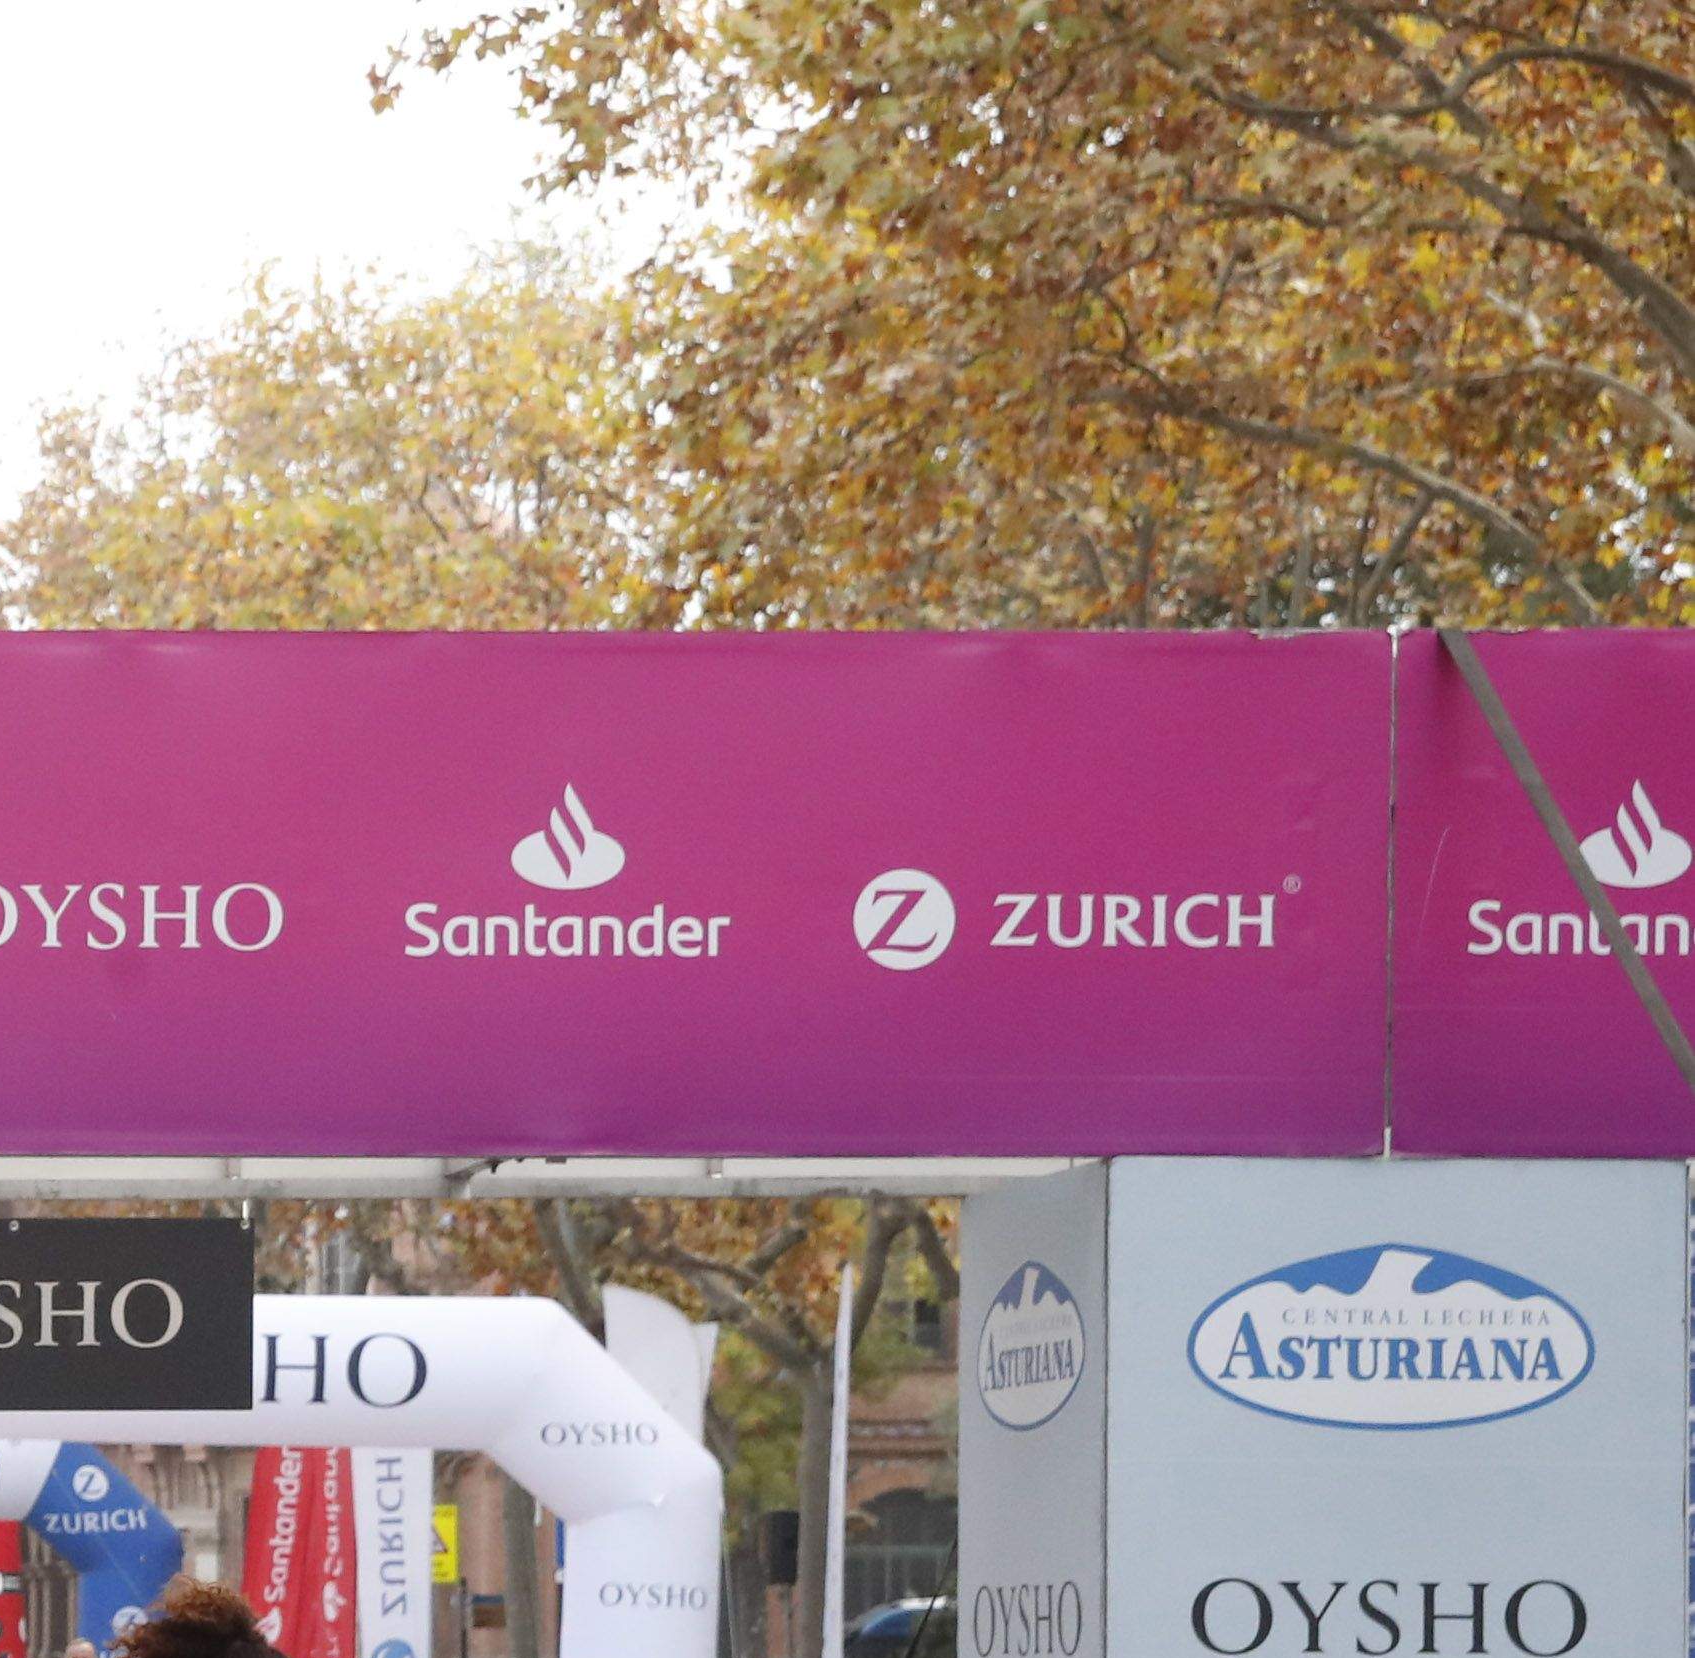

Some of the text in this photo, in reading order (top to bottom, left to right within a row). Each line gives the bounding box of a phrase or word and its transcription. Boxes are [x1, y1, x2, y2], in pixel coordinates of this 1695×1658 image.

[403, 901, 731, 960] Santander
[989, 892, 1277, 949] ZURICH
[1467, 898, 1695, 957] Santan
[1217, 1310, 1565, 1382] ASTURIANA
[1282, 1307, 1551, 1326] CENTRAL LECHERA
[983, 1331, 1076, 1393] ASTURIANA
[539, 1421, 659, 1446] OYSHO
[45, 1507, 148, 1535] ZURICH
[598, 1580, 709, 1610] OYSHO
[972, 1579, 1082, 1658] OYSHO
[1190, 1576, 1588, 1657] OYSHO
